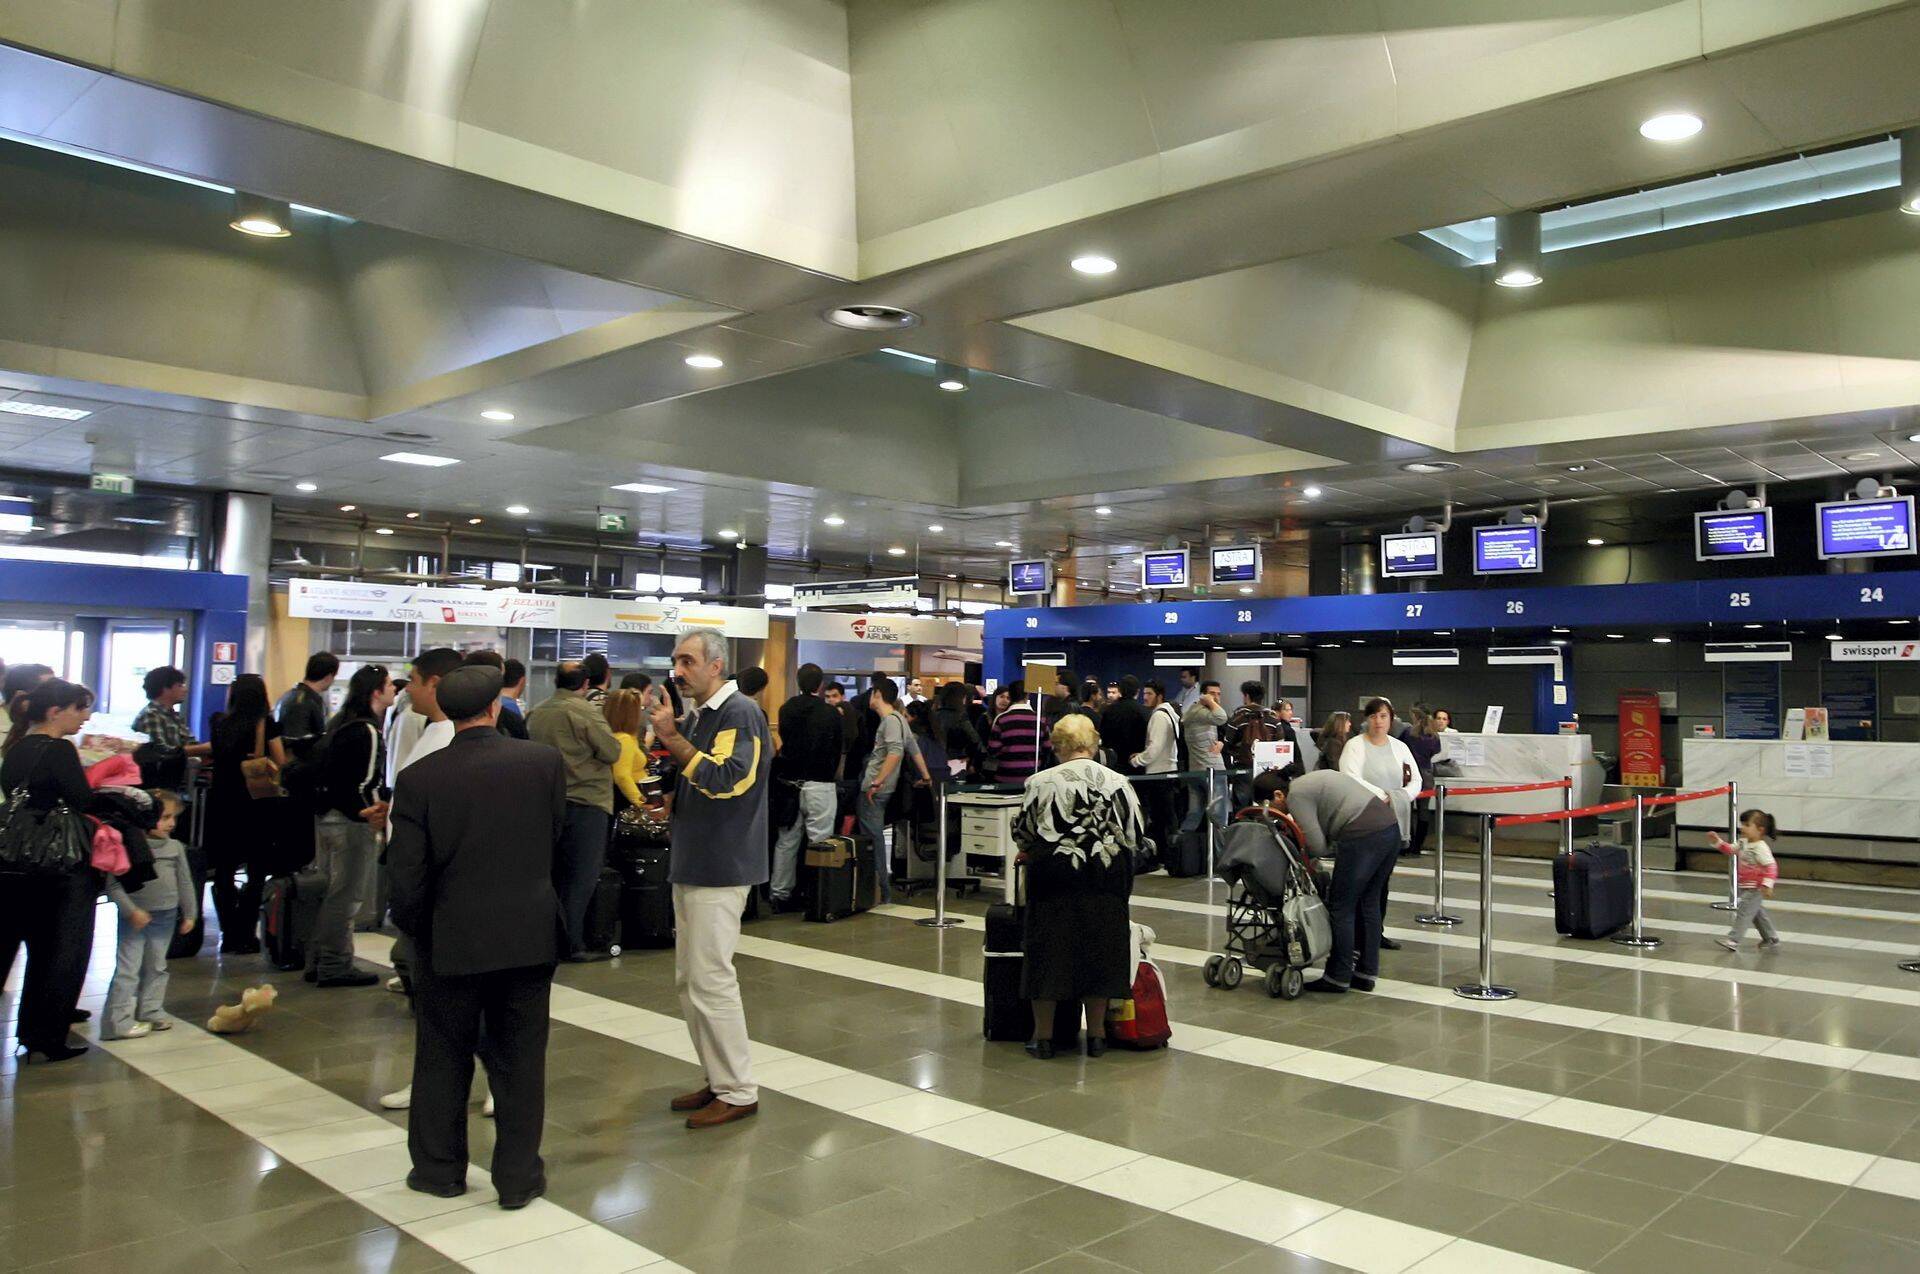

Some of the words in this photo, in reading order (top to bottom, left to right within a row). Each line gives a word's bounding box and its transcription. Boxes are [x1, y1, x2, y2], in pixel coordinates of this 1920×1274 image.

[92, 475, 120, 490] EXIT
[1729, 593, 1751, 607] 25
[1860, 588, 1884, 602] 24
[1406, 605, 1423, 617] 27
[1506, 601, 1524, 614] 26
[387, 609, 424, 620] ASTRA
[1164, 612, 1178, 624] 29
[1237, 610, 1252, 622] 28
[1026, 617, 1038, 628] 30
[866, 633, 898, 641] AIRLINES
[1842, 644, 1897, 658] swissport
